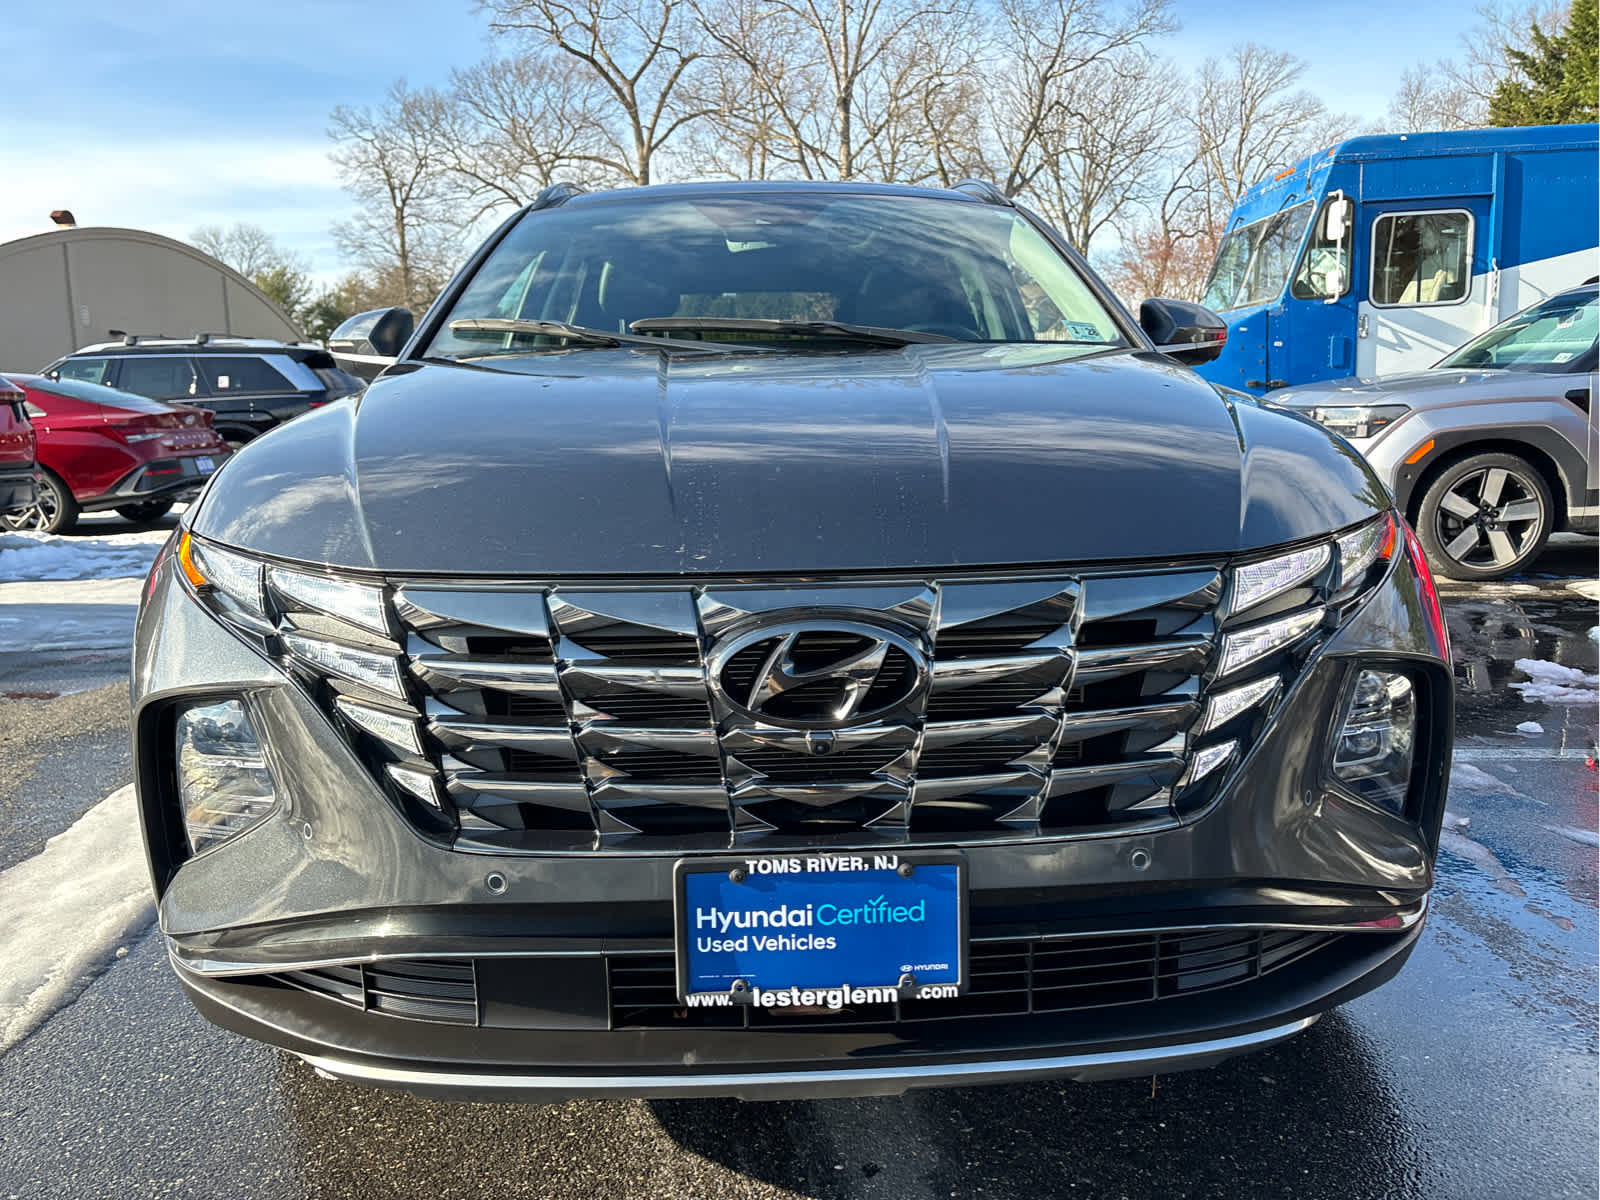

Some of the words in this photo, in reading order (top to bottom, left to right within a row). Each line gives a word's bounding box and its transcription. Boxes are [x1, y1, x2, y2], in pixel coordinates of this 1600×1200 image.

[745, 858, 801, 875] TOMS
[806, 856, 868, 873] RIVER,
[874, 854, 899, 870] NJ
[696, 903, 813, 934] Hyundai
[816, 894, 925, 926] Certified
[697, 935, 749, 953] Used
[751, 933, 837, 952] Vehicles
[685, 994, 734, 1008] www.
[753, 983, 898, 1009] lesterglenn
[915, 984, 959, 1000] .com
